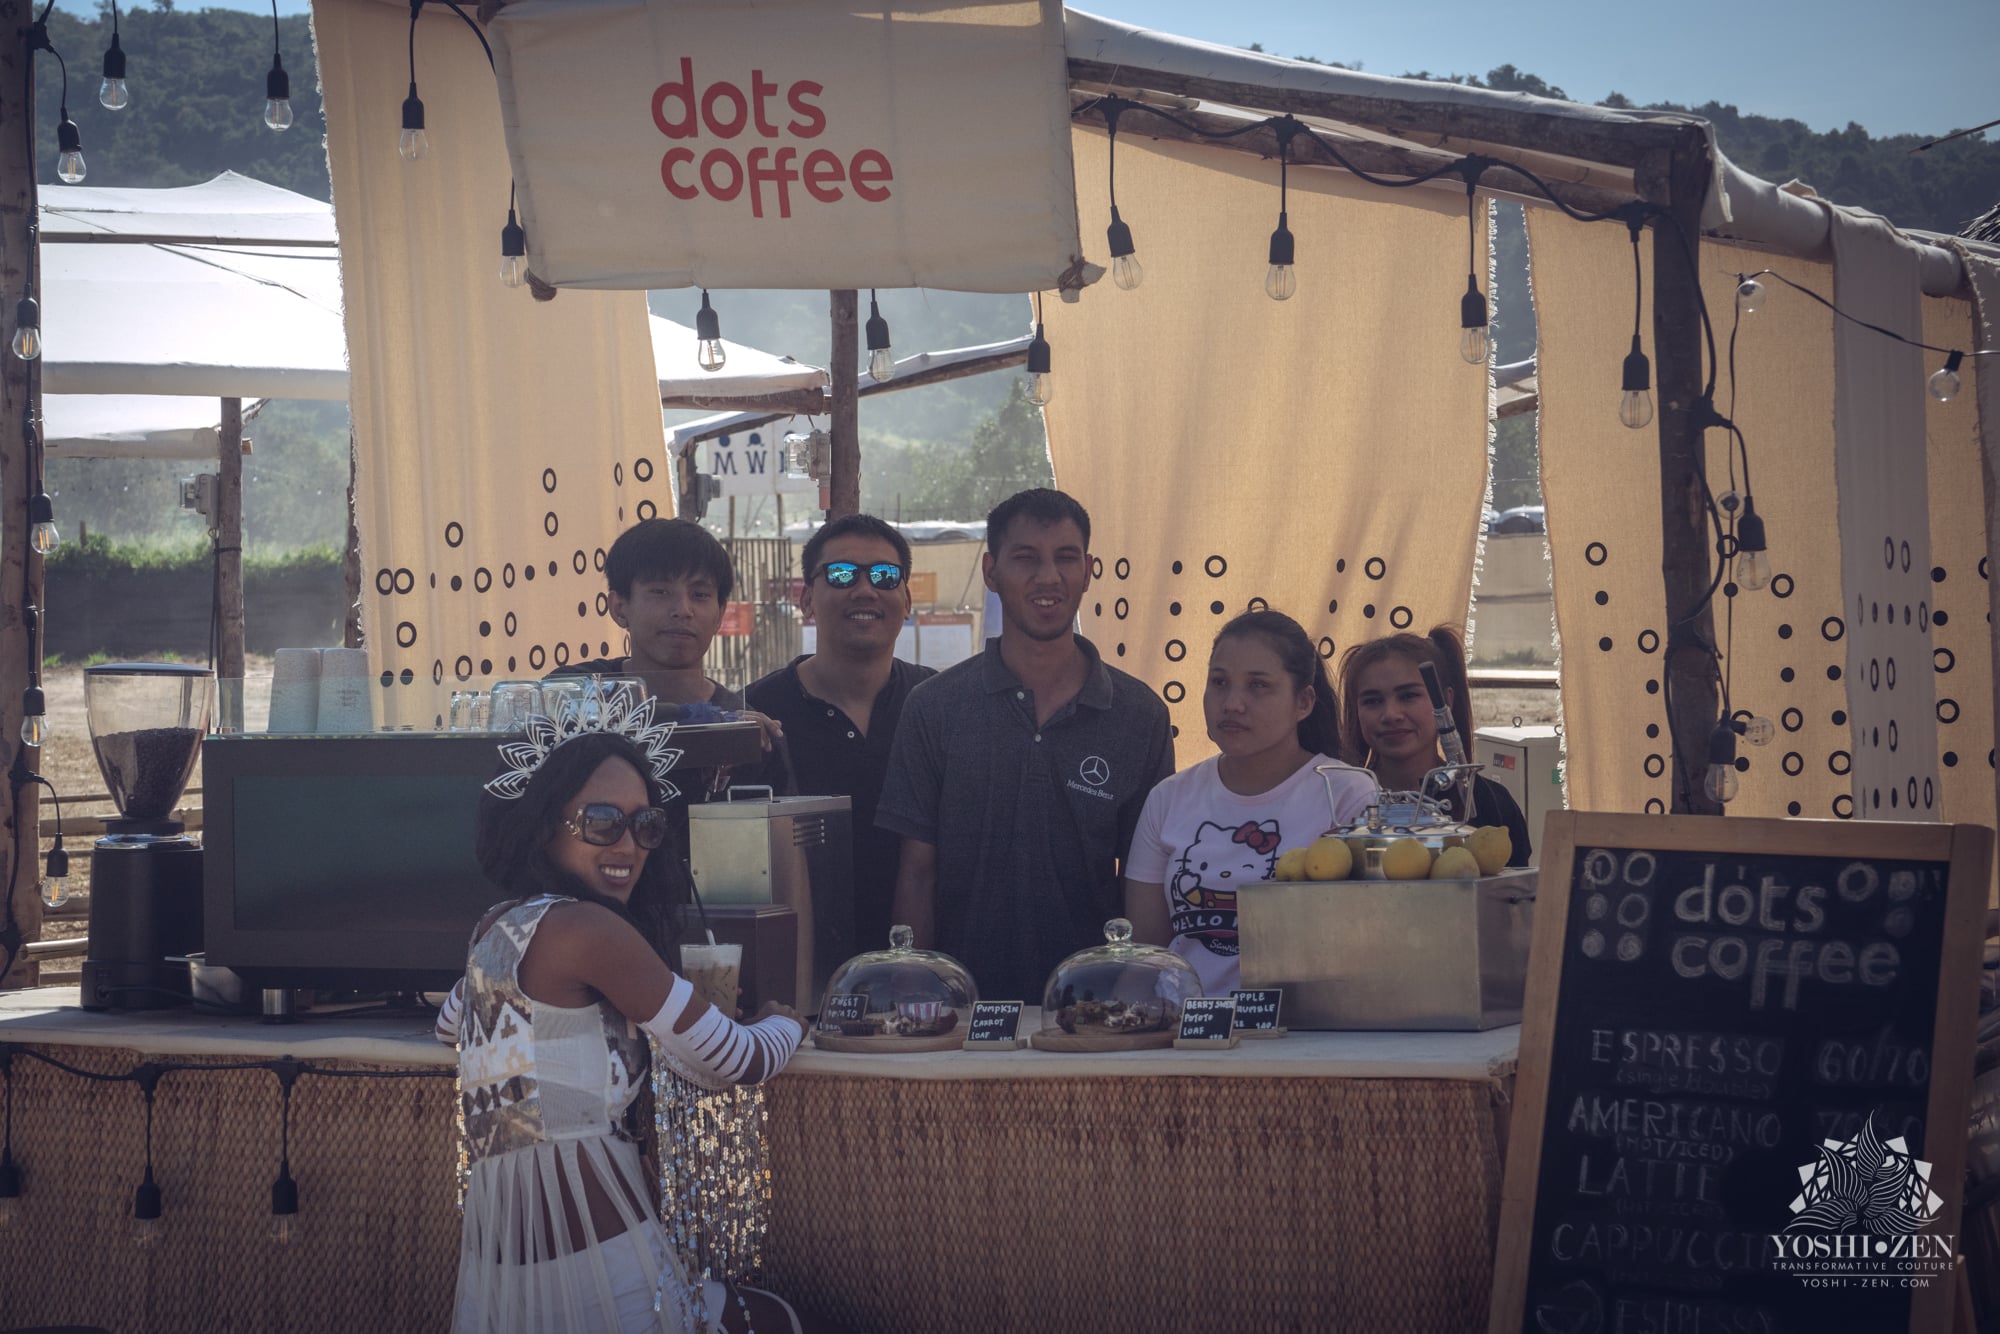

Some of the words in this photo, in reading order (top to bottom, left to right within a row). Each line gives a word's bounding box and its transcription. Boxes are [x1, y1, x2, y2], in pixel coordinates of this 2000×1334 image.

[651, 57, 826, 139] dots
[661, 147, 893, 218] coffee
[1674, 864, 1827, 932] dots
[1172, 915, 1223, 932] HELLO
[1671, 935, 1901, 1011] coffee
[973, 1018, 1004, 1028] CARROT
[976, 1004, 1019, 1014] PUMPKIN
[1186, 1000, 1213, 1010] BERRY
[1236, 1004, 1276, 1014] RUMBLE
[1183, 1026, 1205, 1036] LOAF
[1592, 1029, 1784, 1076] ESPRESSO
[1568, 1096, 1783, 1147] AMERICANO
[1578, 1154, 1719, 1204] LATTE
